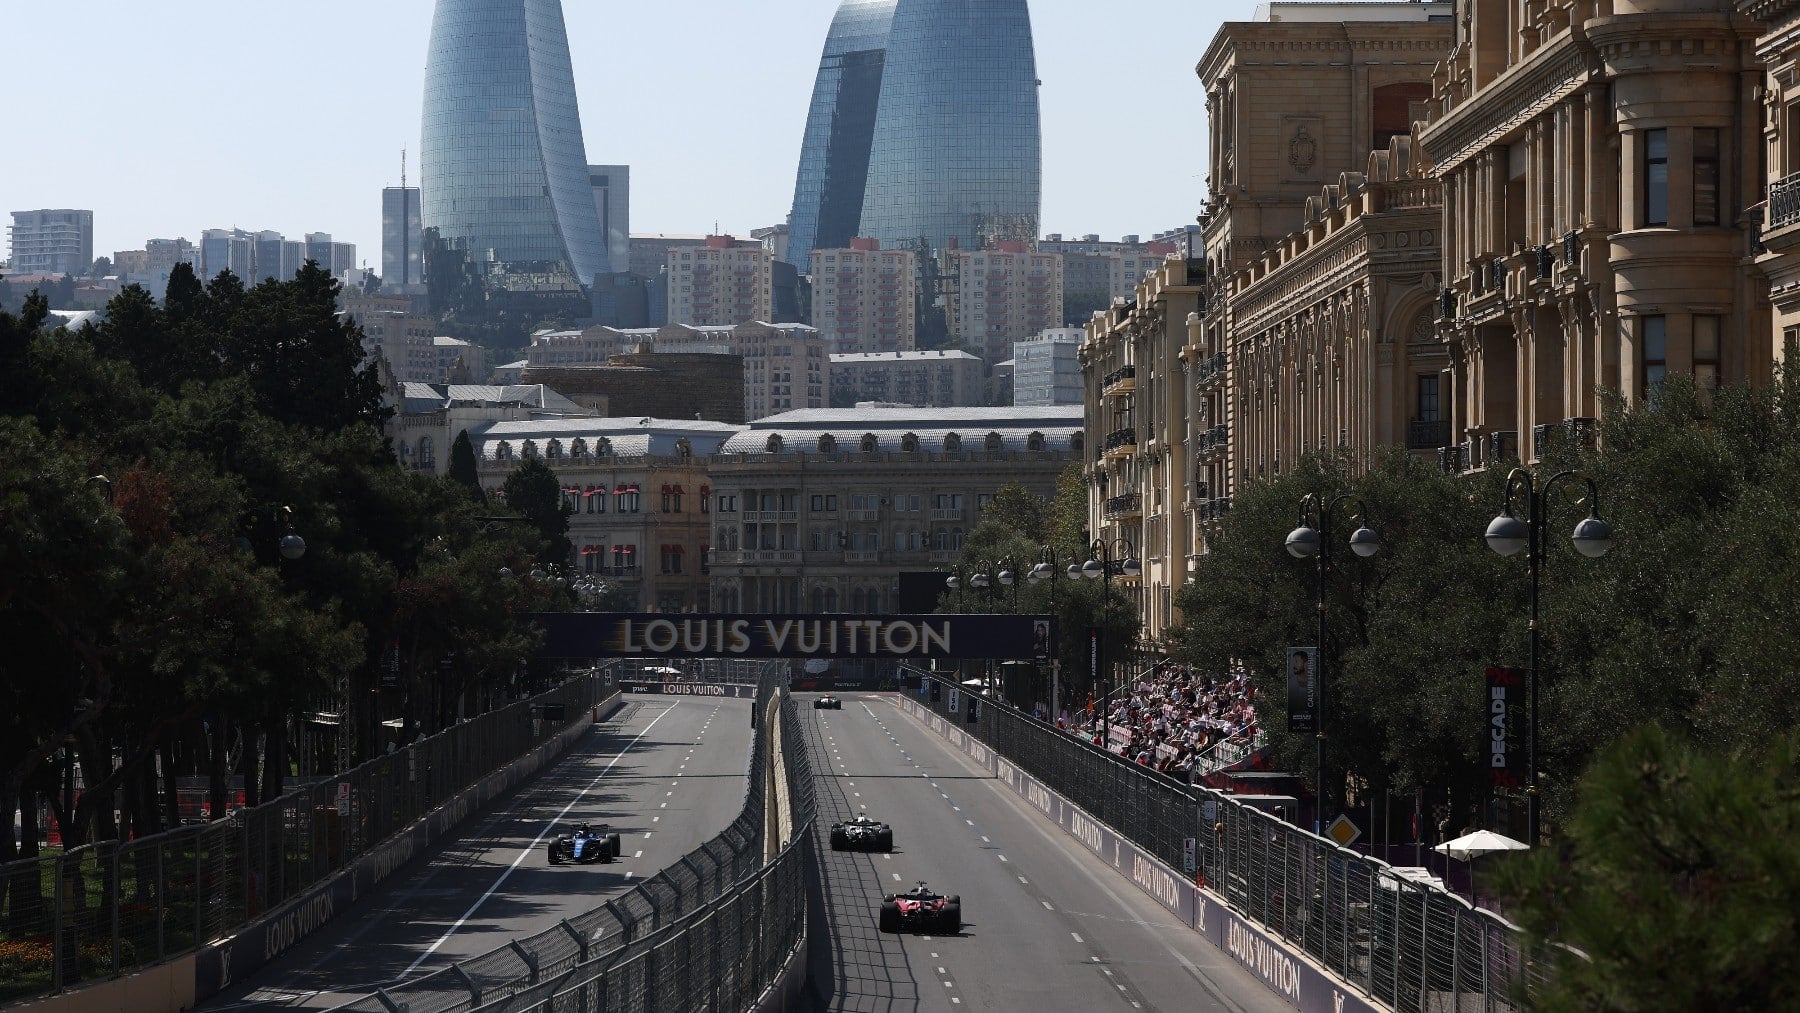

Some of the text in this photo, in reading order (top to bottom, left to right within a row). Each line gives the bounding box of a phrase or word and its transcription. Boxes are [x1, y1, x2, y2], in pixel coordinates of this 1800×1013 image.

[623, 619, 950, 654] LOUIS VUITTON
[663, 684, 724, 696] LOUIS VUITTON
[1491, 687, 1505, 767] DECADE
[1134, 853, 1179, 910] LOUIS VUITTON
[265, 888, 334, 960] LOUIS VUITTON
[1229, 917, 1300, 1000] LOUIS VUITTON
